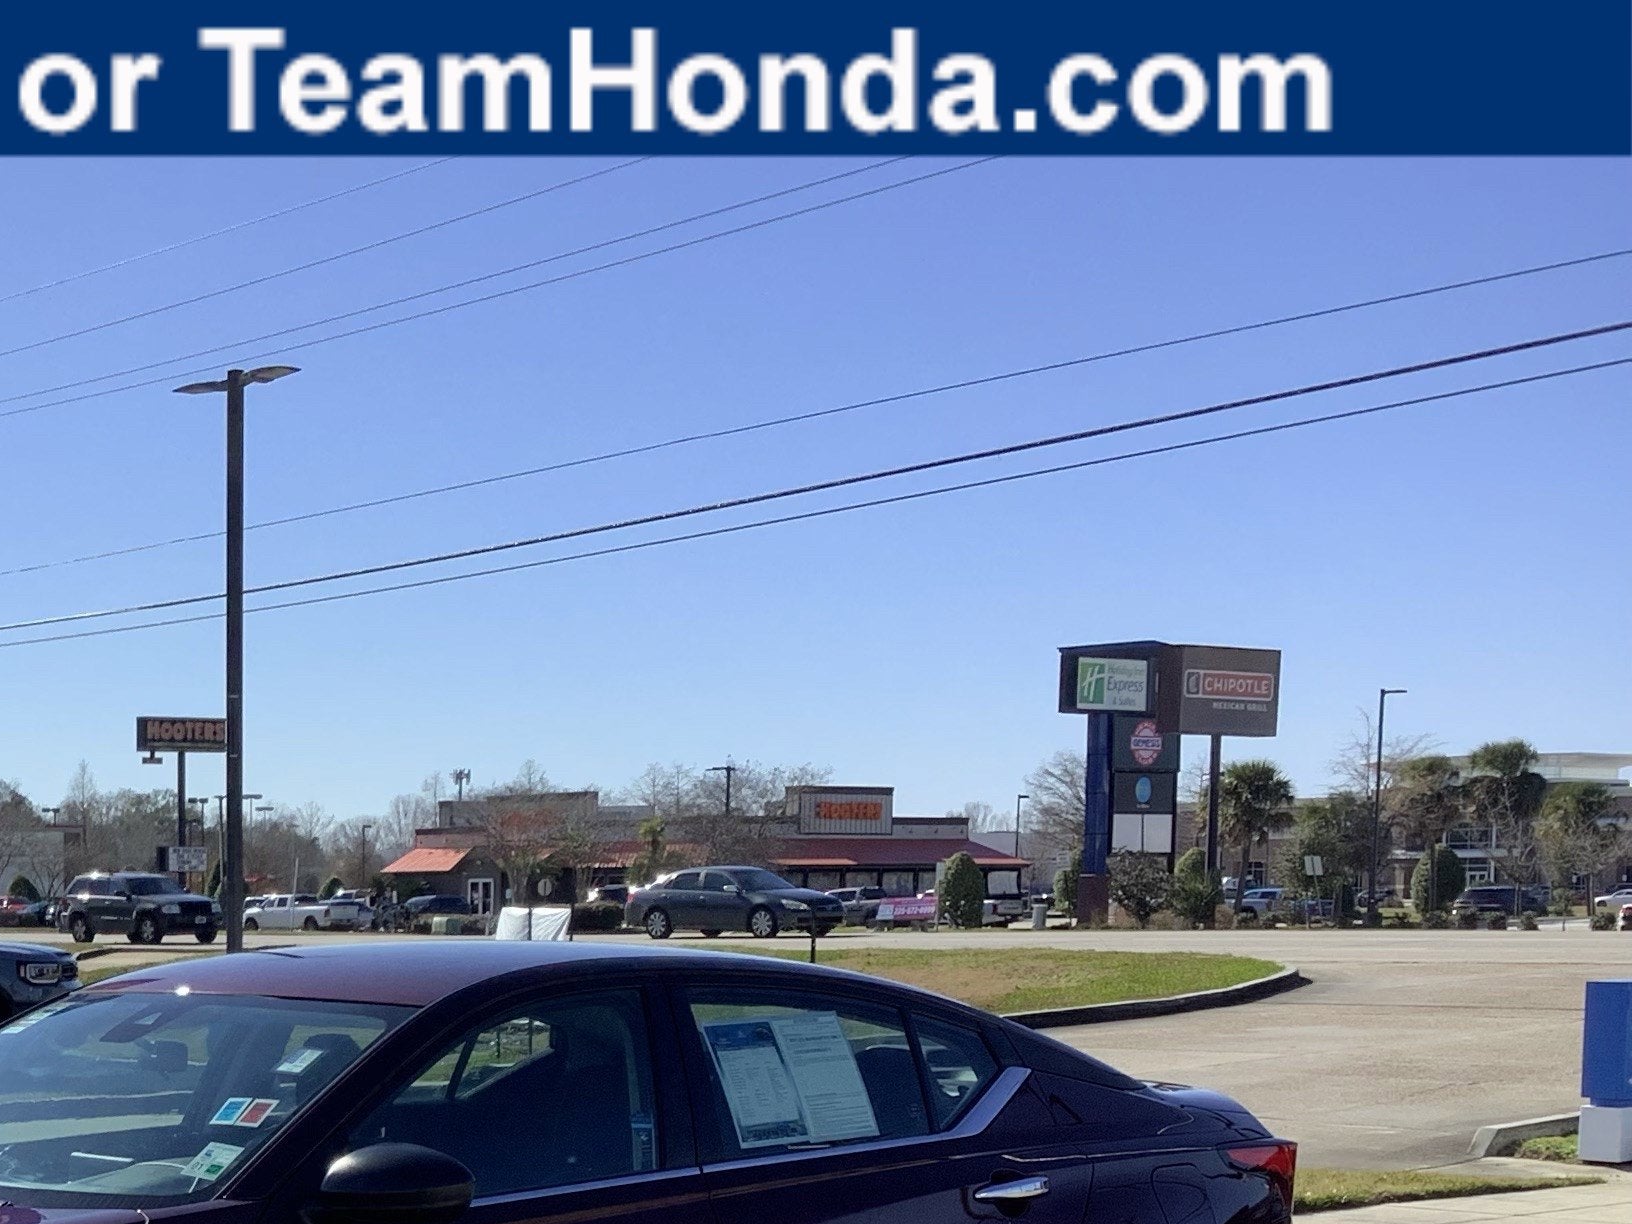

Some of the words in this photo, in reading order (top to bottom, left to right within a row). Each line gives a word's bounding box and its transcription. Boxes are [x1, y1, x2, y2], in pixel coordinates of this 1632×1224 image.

[1107, 676, 1145, 694] Express
[1204, 677, 1270, 694] CHIPOTLE
[146, 720, 225, 740] HOOTERS
